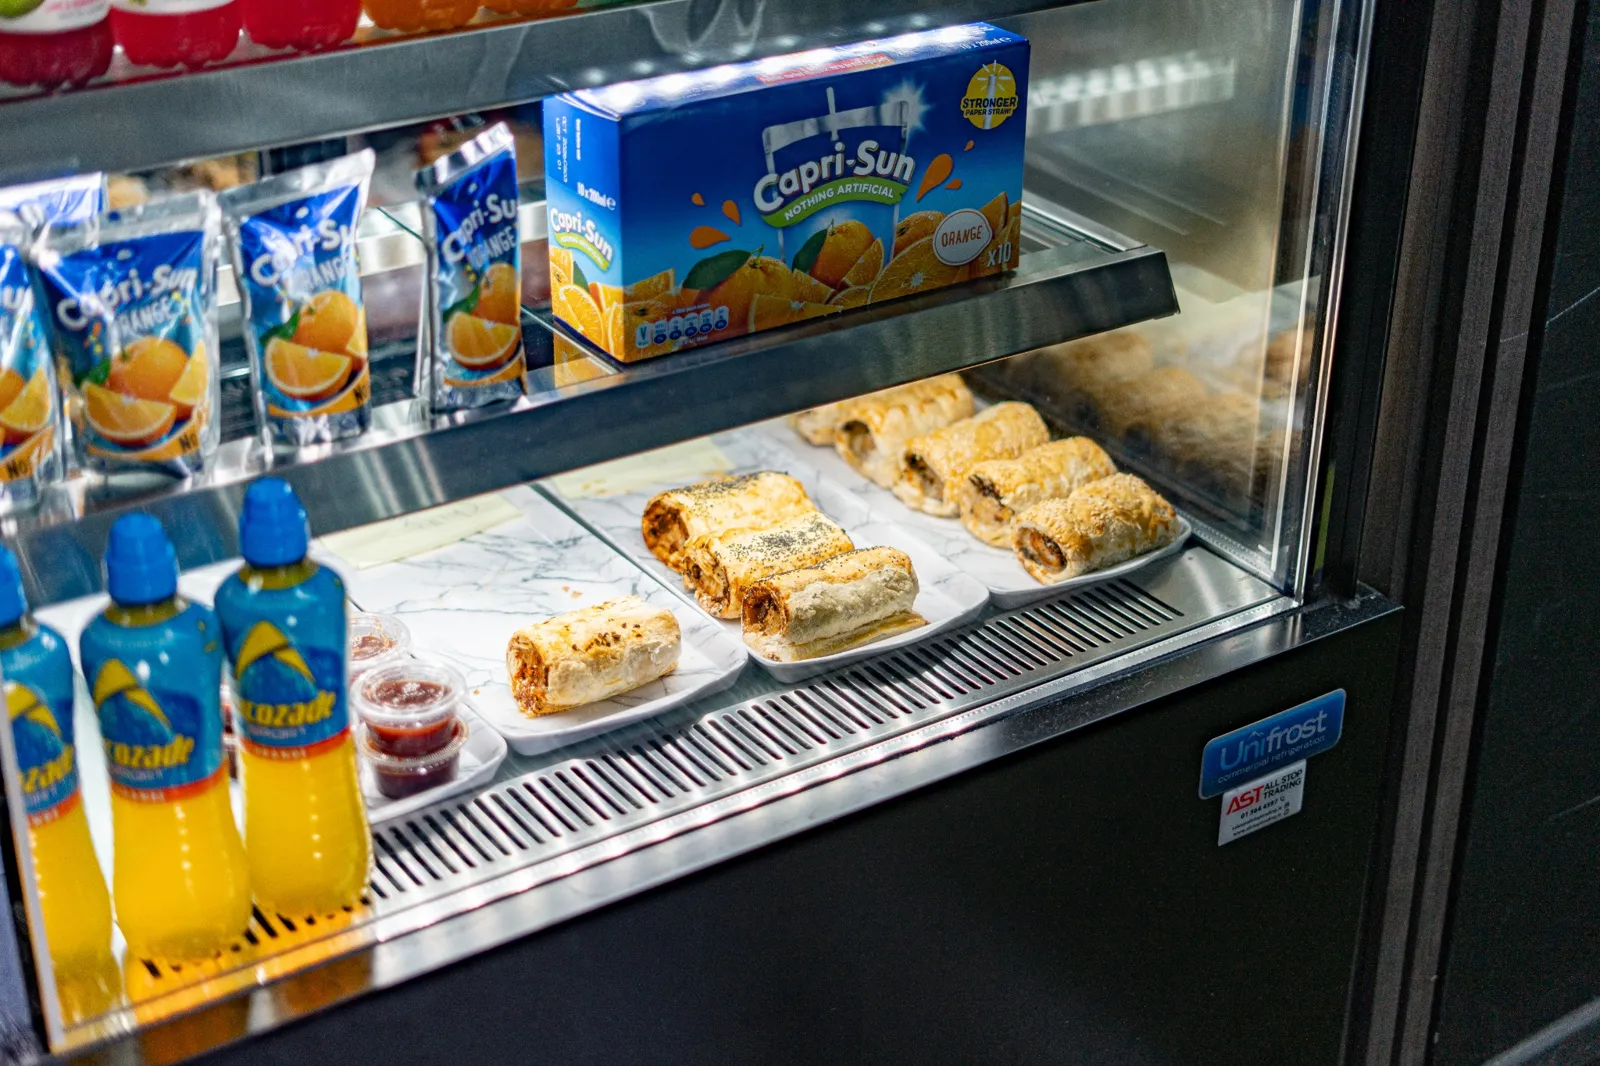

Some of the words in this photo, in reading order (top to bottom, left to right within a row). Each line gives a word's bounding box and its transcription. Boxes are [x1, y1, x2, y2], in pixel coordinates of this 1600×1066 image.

[962, 96, 1017, 109] STRONGER
[753, 139, 916, 214] Capri-Sun
[784, 187, 835, 222] NOTHING
[837, 182, 895, 199] ARTIFICIAL
[550, 207, 613, 262] Capri-Sun
[941, 224, 983, 248] ORANGE
[1219, 709, 1328, 771] Unifrost
[1218, 755, 1270, 784] commercial
[1271, 734, 1326, 763] refrigeration
[1263, 778, 1280, 791] ALL
[1281, 768, 1303, 784] STOP
[1263, 777, 1302, 799] TRADING
[1226, 784, 1265, 815] AST
